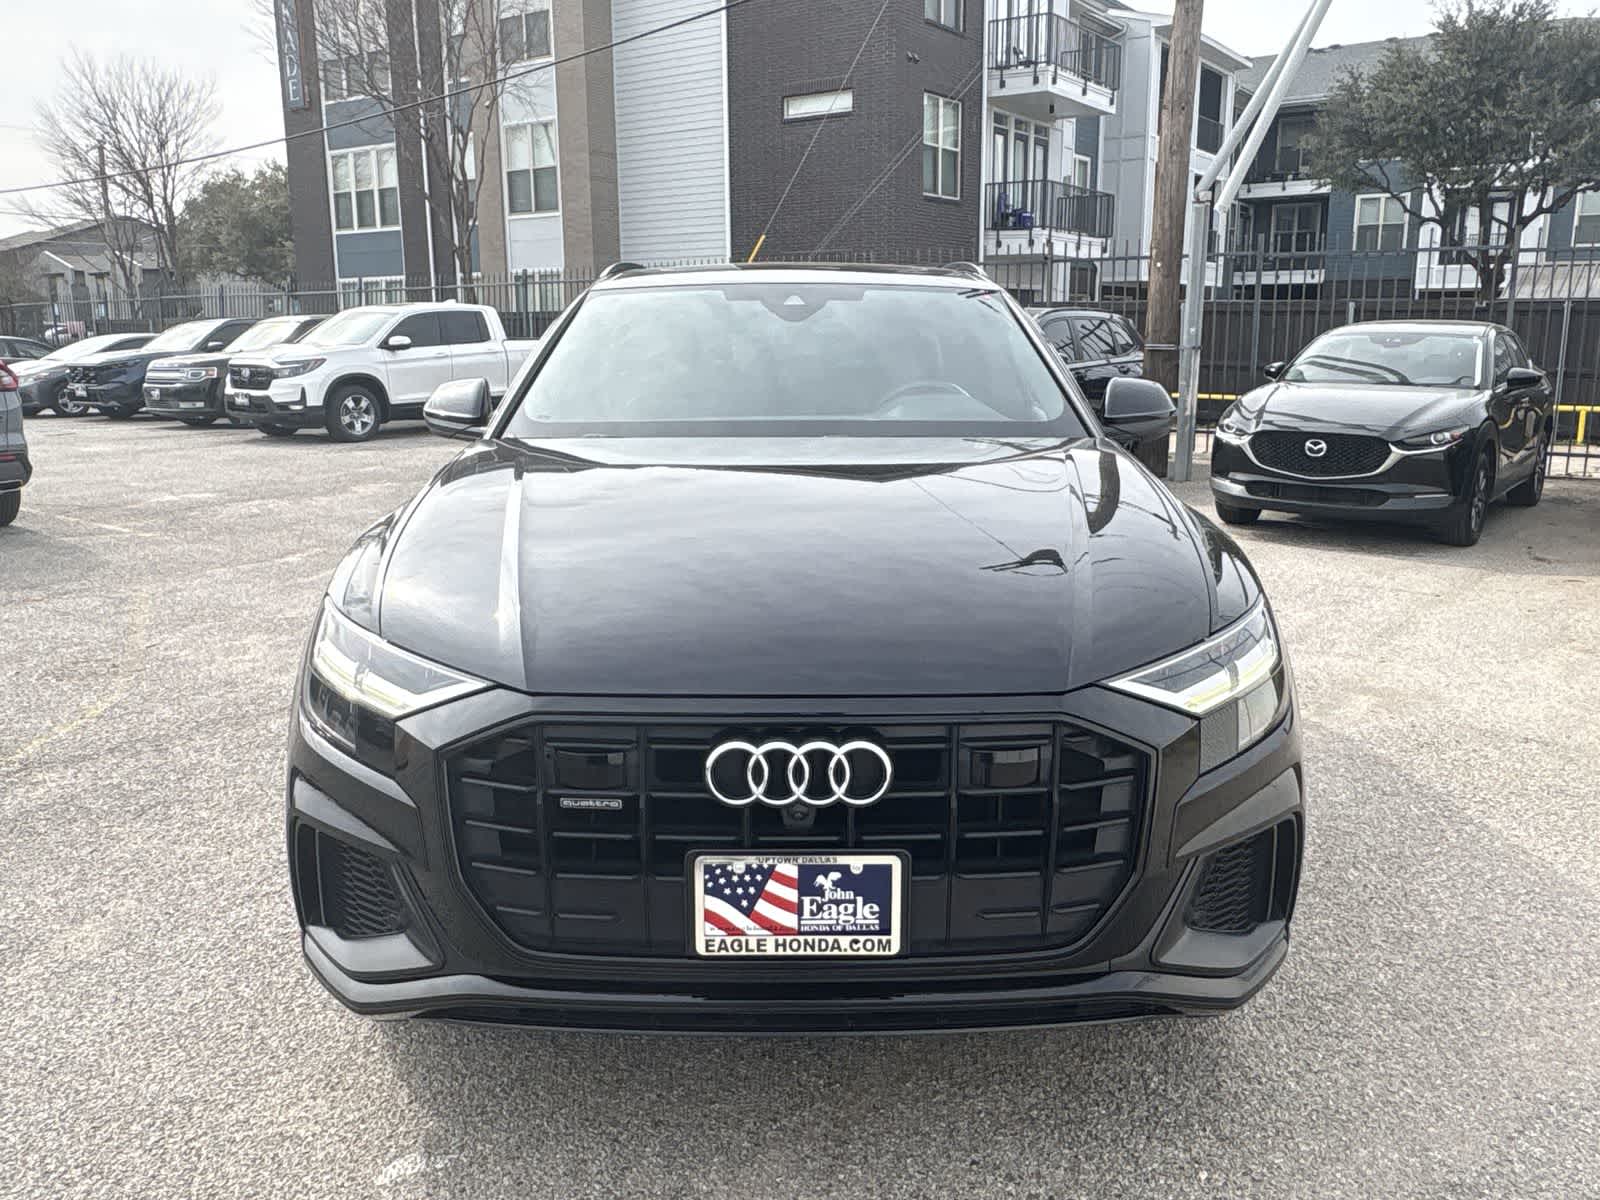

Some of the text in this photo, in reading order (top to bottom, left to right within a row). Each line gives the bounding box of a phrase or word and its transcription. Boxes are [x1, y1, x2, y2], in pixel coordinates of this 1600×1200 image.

[562, 799, 620, 809] quattro
[758, 856, 838, 864] UPTOWN DALLAS
[822, 887, 855, 902] John
[800, 896, 880, 925] Eagle
[704, 938, 892, 953] EAGLE HONDA.COM
